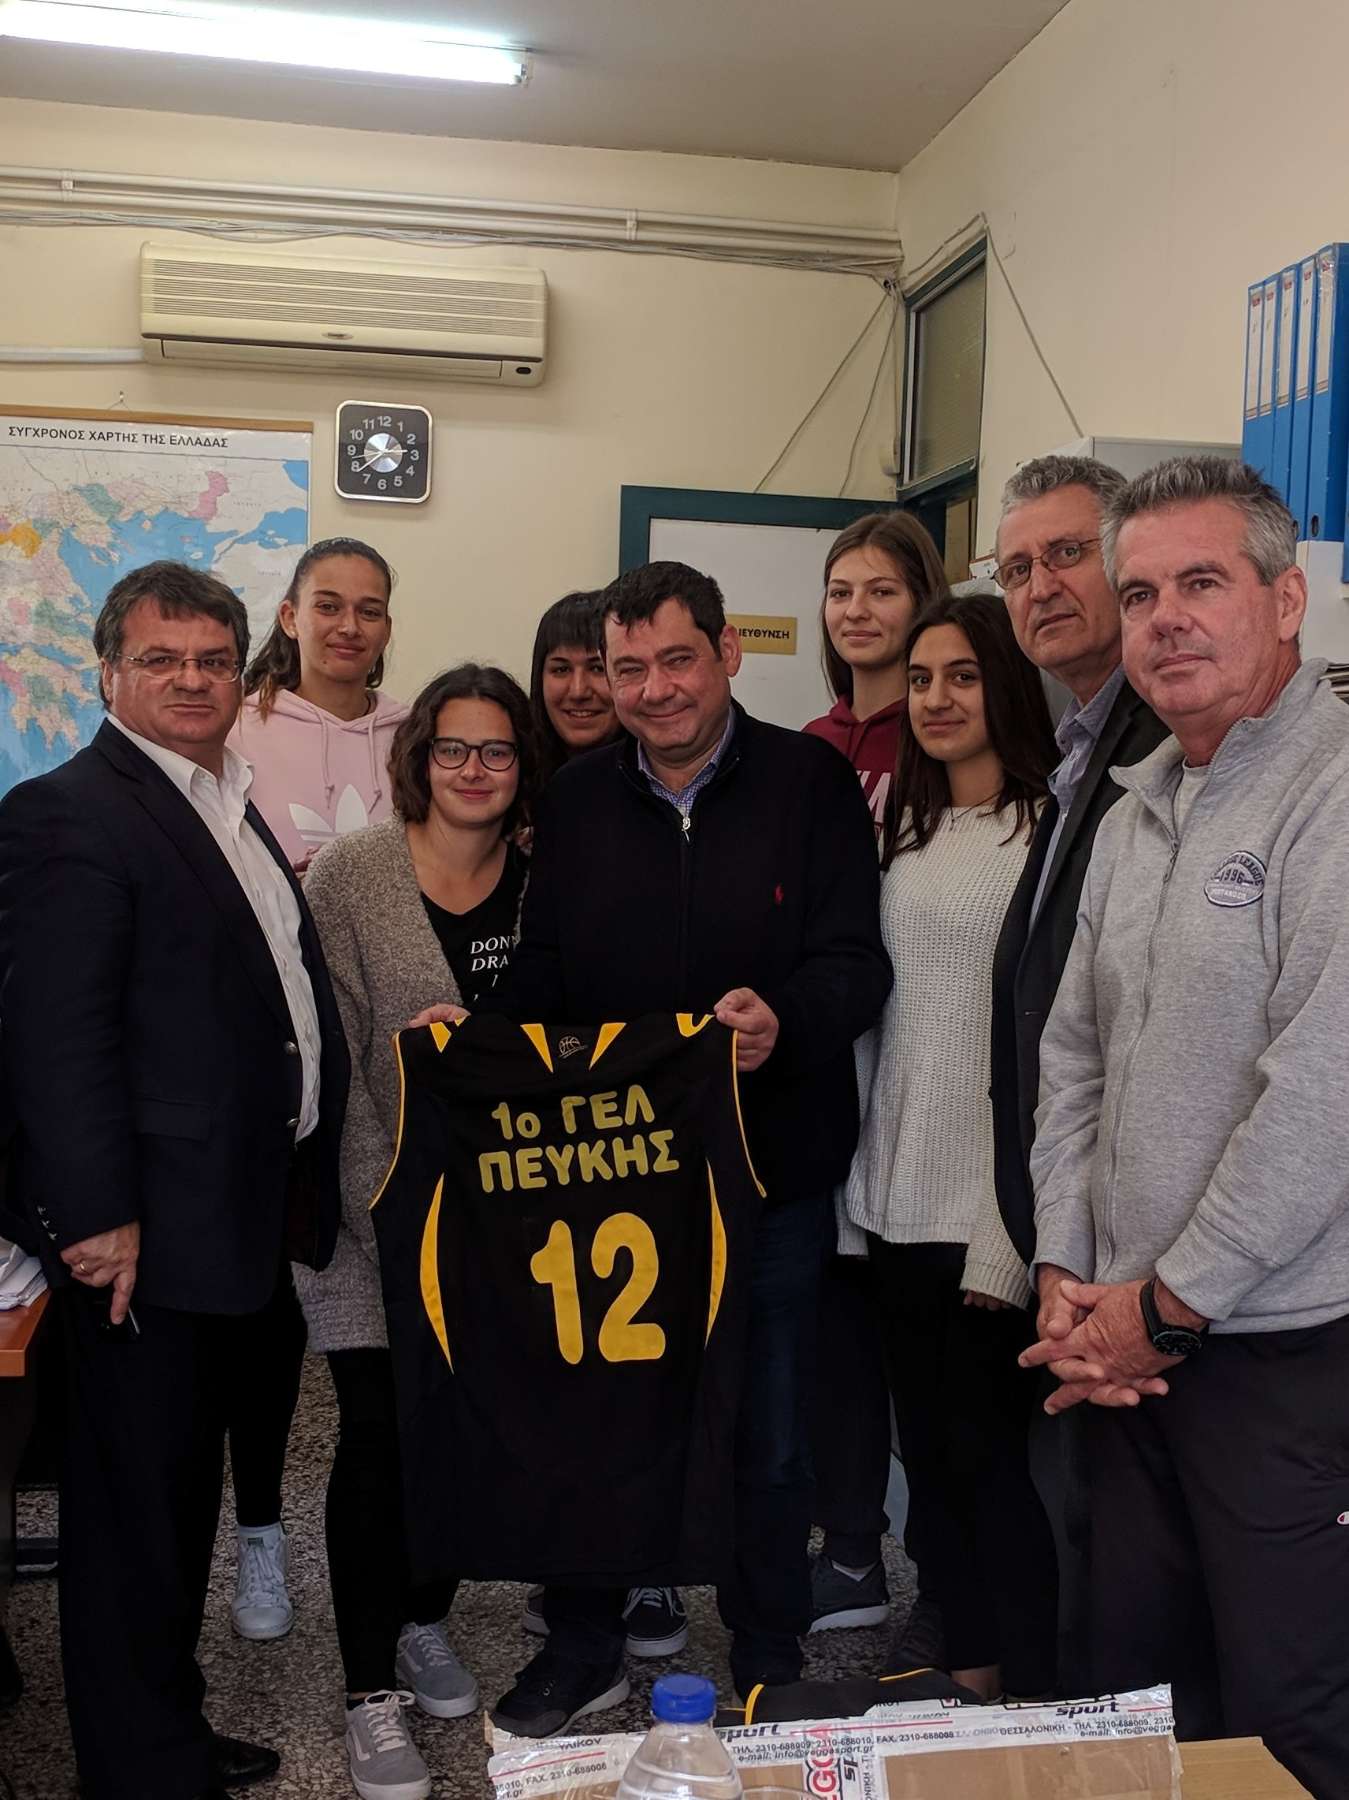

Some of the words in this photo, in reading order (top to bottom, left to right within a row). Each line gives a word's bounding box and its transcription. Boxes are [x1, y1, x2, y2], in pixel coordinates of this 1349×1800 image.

[362, 419, 375, 430] 11
[377, 416, 392, 427] 12
[397, 421, 404, 432] 1
[8, 426, 85, 441] ΣΥΓΧΡΟΝΟΣ
[88, 431, 139, 444] ΧΑΡΤΗΣ
[142, 433, 166, 445] ΤΗΣ
[169, 434, 229, 448] ΕΛΛΑΔΑΣ
[349, 429, 364, 440] 10
[406, 434, 416, 445] 2
[347, 445, 356, 456] 9
[410, 449, 420, 461] 3
[351, 461, 360, 472] 8
[405, 465, 415, 476] 4
[362, 473, 371, 484] 7
[393, 476, 403, 487] 5
[377, 479, 387, 490] 6
[738, 628, 790, 640] ΙΕΥΘΥΝΣΗ
[560, 1084, 655, 1135] ΓΕΛ
[478, 1129, 680, 1193] ΠΕΥΚΗΣ
[530, 1212, 666, 1365] 12
